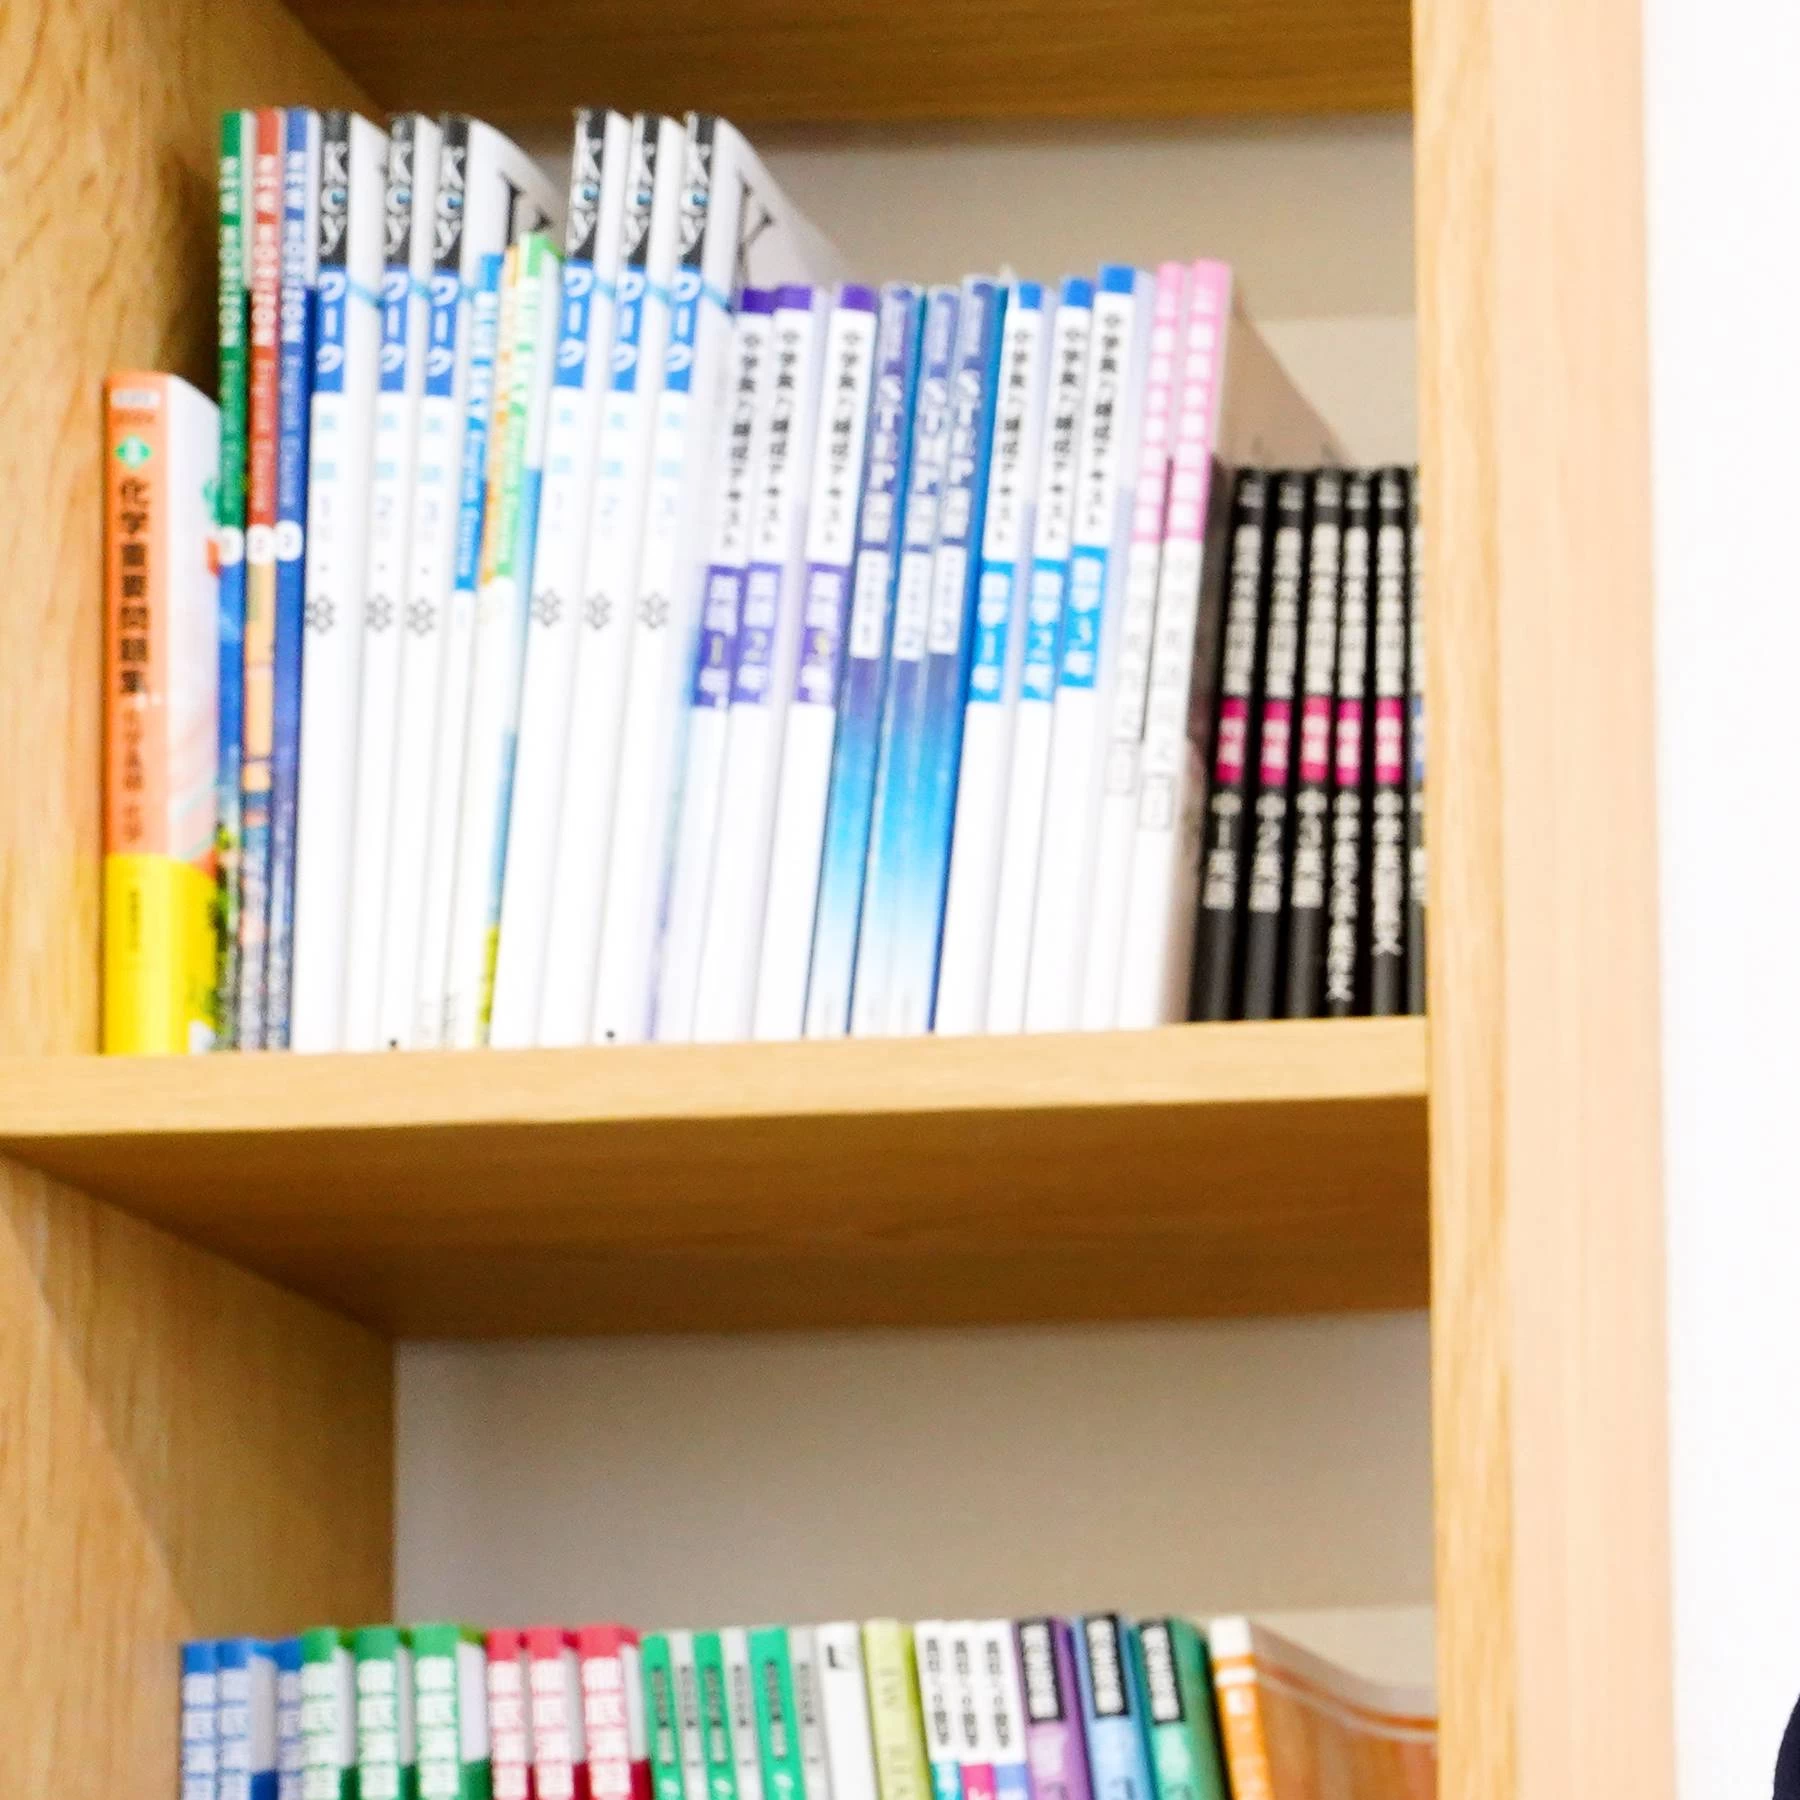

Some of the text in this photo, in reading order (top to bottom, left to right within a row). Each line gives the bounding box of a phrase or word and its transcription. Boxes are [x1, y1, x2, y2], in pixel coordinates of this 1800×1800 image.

[315, 271, 346, 373] ワーク
[380, 271, 408, 372] ワーク
[426, 275, 459, 376] ワーク
[558, 267, 593, 369] ワーク
[612, 269, 645, 373] ワーク
[665, 271, 700, 373] ワーク
